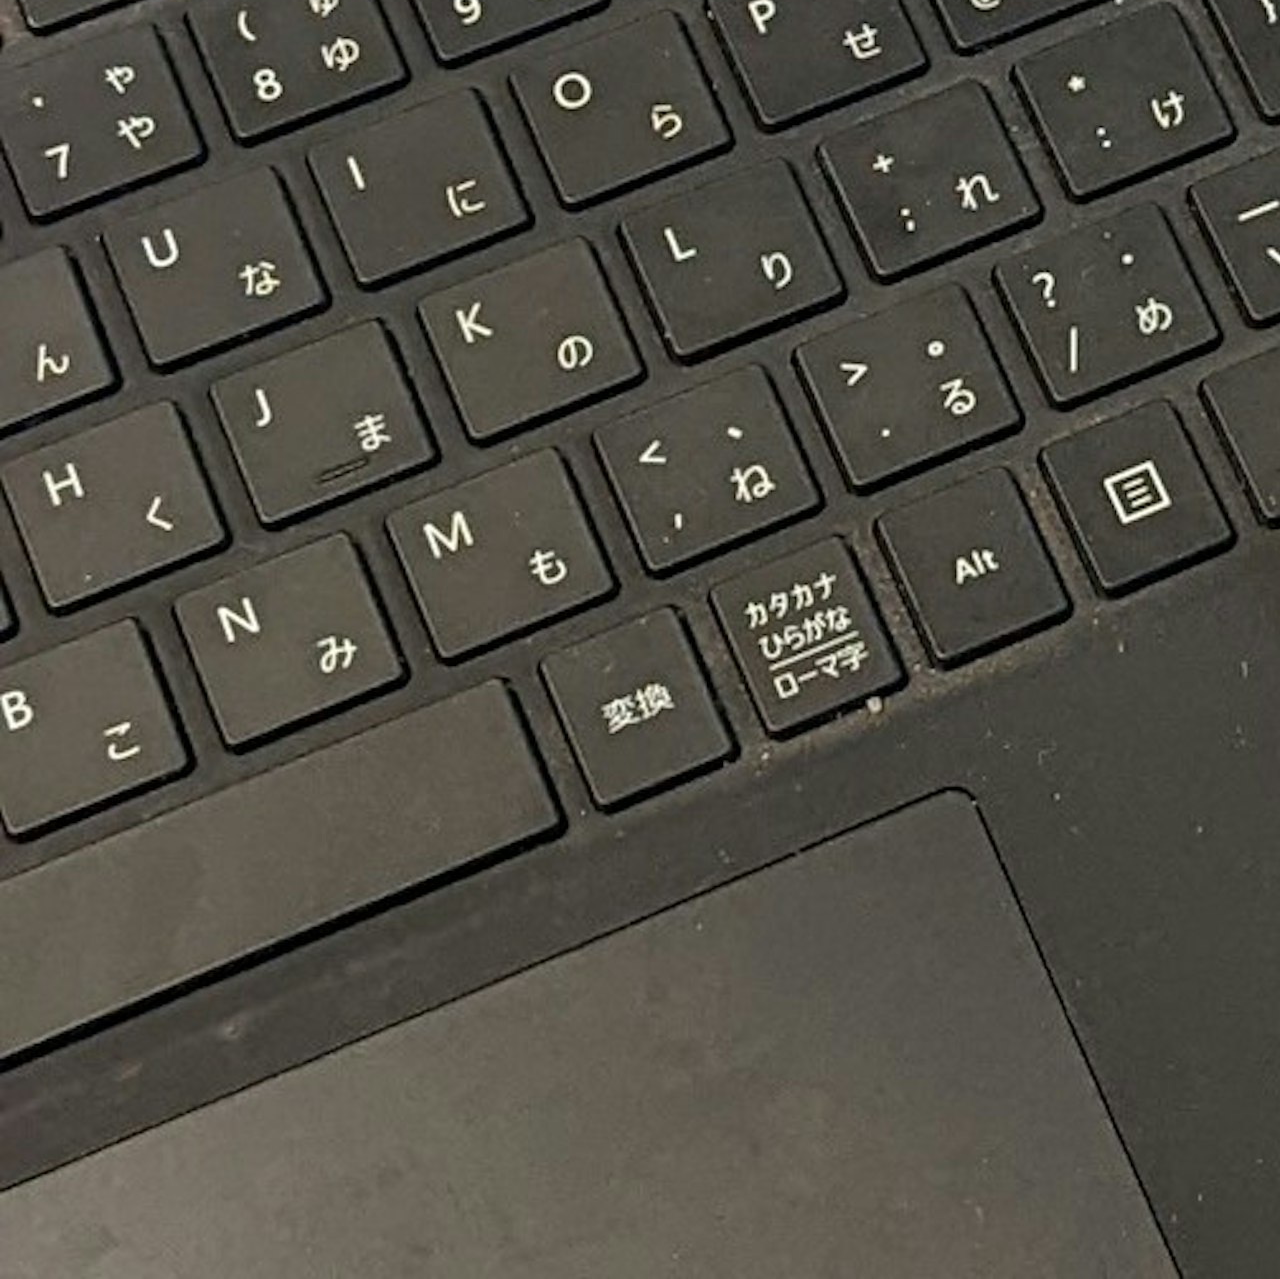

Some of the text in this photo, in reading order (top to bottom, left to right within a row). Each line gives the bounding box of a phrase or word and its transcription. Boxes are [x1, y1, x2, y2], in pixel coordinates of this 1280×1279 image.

[321, 36, 361, 73] ゆ
[843, 21, 882, 61] せ
[253, 67, 283, 103] 8
[651, 103, 683, 139] ら
[1151, 90, 1187, 128] け
[117, 113, 155, 149] や
[44, 143, 72, 180] 7
[446, 179, 486, 218] に
[955, 172, 1000, 211] れ
[141, 228, 181, 269] U
[664, 225, 697, 262] L
[239, 261, 281, 298] な
[760, 251, 793, 289] り
[1031, 270, 1058, 308] ?
[455, 302, 494, 343] K
[1136, 297, 1174, 335] め
[36, 344, 71, 381] ん
[556, 334, 595, 371] の
[253, 387, 273, 428] J
[939, 379, 976, 417] る
[354, 414, 392, 452] ま
[42, 462, 85, 507] H
[730, 464, 776, 504] ね
[145, 496, 174, 531] く
[422, 511, 475, 559] M
[528, 548, 569, 586] も
[954, 548, 1000, 585] Alt
[216, 597, 261, 643] N
[746, 573, 837, 629] カタカナ
[758, 603, 853, 659] ひらがな
[316, 636, 358, 673] み
[774, 641, 869, 700] ローマ字
[0, 689, 34, 732] B
[601, 681, 675, 734] 変換
[103, 721, 141, 761] こ
